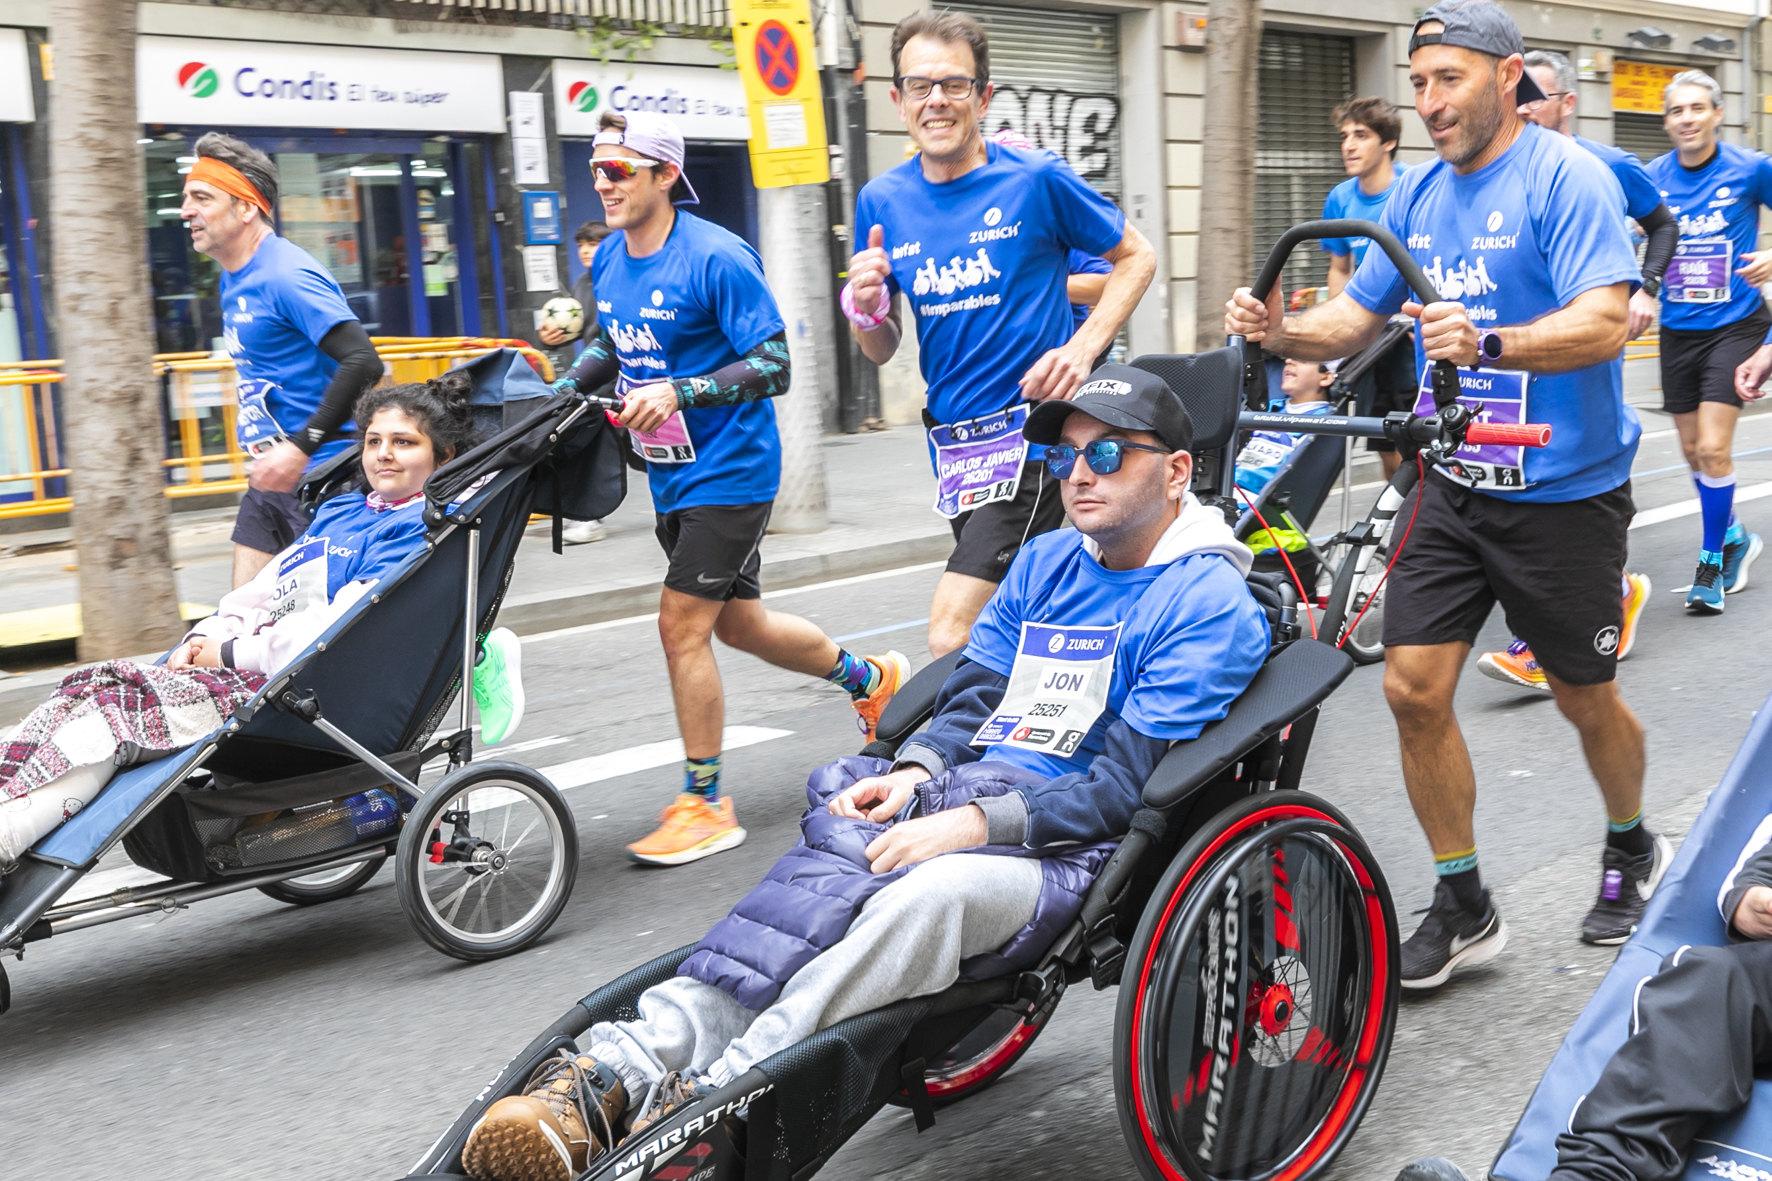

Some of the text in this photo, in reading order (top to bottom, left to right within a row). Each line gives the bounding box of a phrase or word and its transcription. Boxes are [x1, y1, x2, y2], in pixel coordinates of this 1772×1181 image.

[234, 67, 338, 100] Condis
[348, 84, 365, 101] El
[609, 86, 689, 114] Condis
[968, 223, 1020, 244] ZURICH
[1471, 235, 1517, 250] ZURICH
[639, 307, 676, 321] ZURICH
[920, 293, 1001, 317] #Imparables
[1459, 377, 1492, 391] URICH
[1253, 414, 1348, 426] www.vipamat.com
[941, 447, 1023, 479] CARLOS JAVIER
[961, 468, 994, 486] 26201
[270, 599, 296, 622] 25248
[1066, 638, 1105, 651] ZURICH
[1044, 672, 1084, 692] JON
[1028, 703, 1068, 718] 25251
[1198, 875, 1239, 1162] MARATHON
